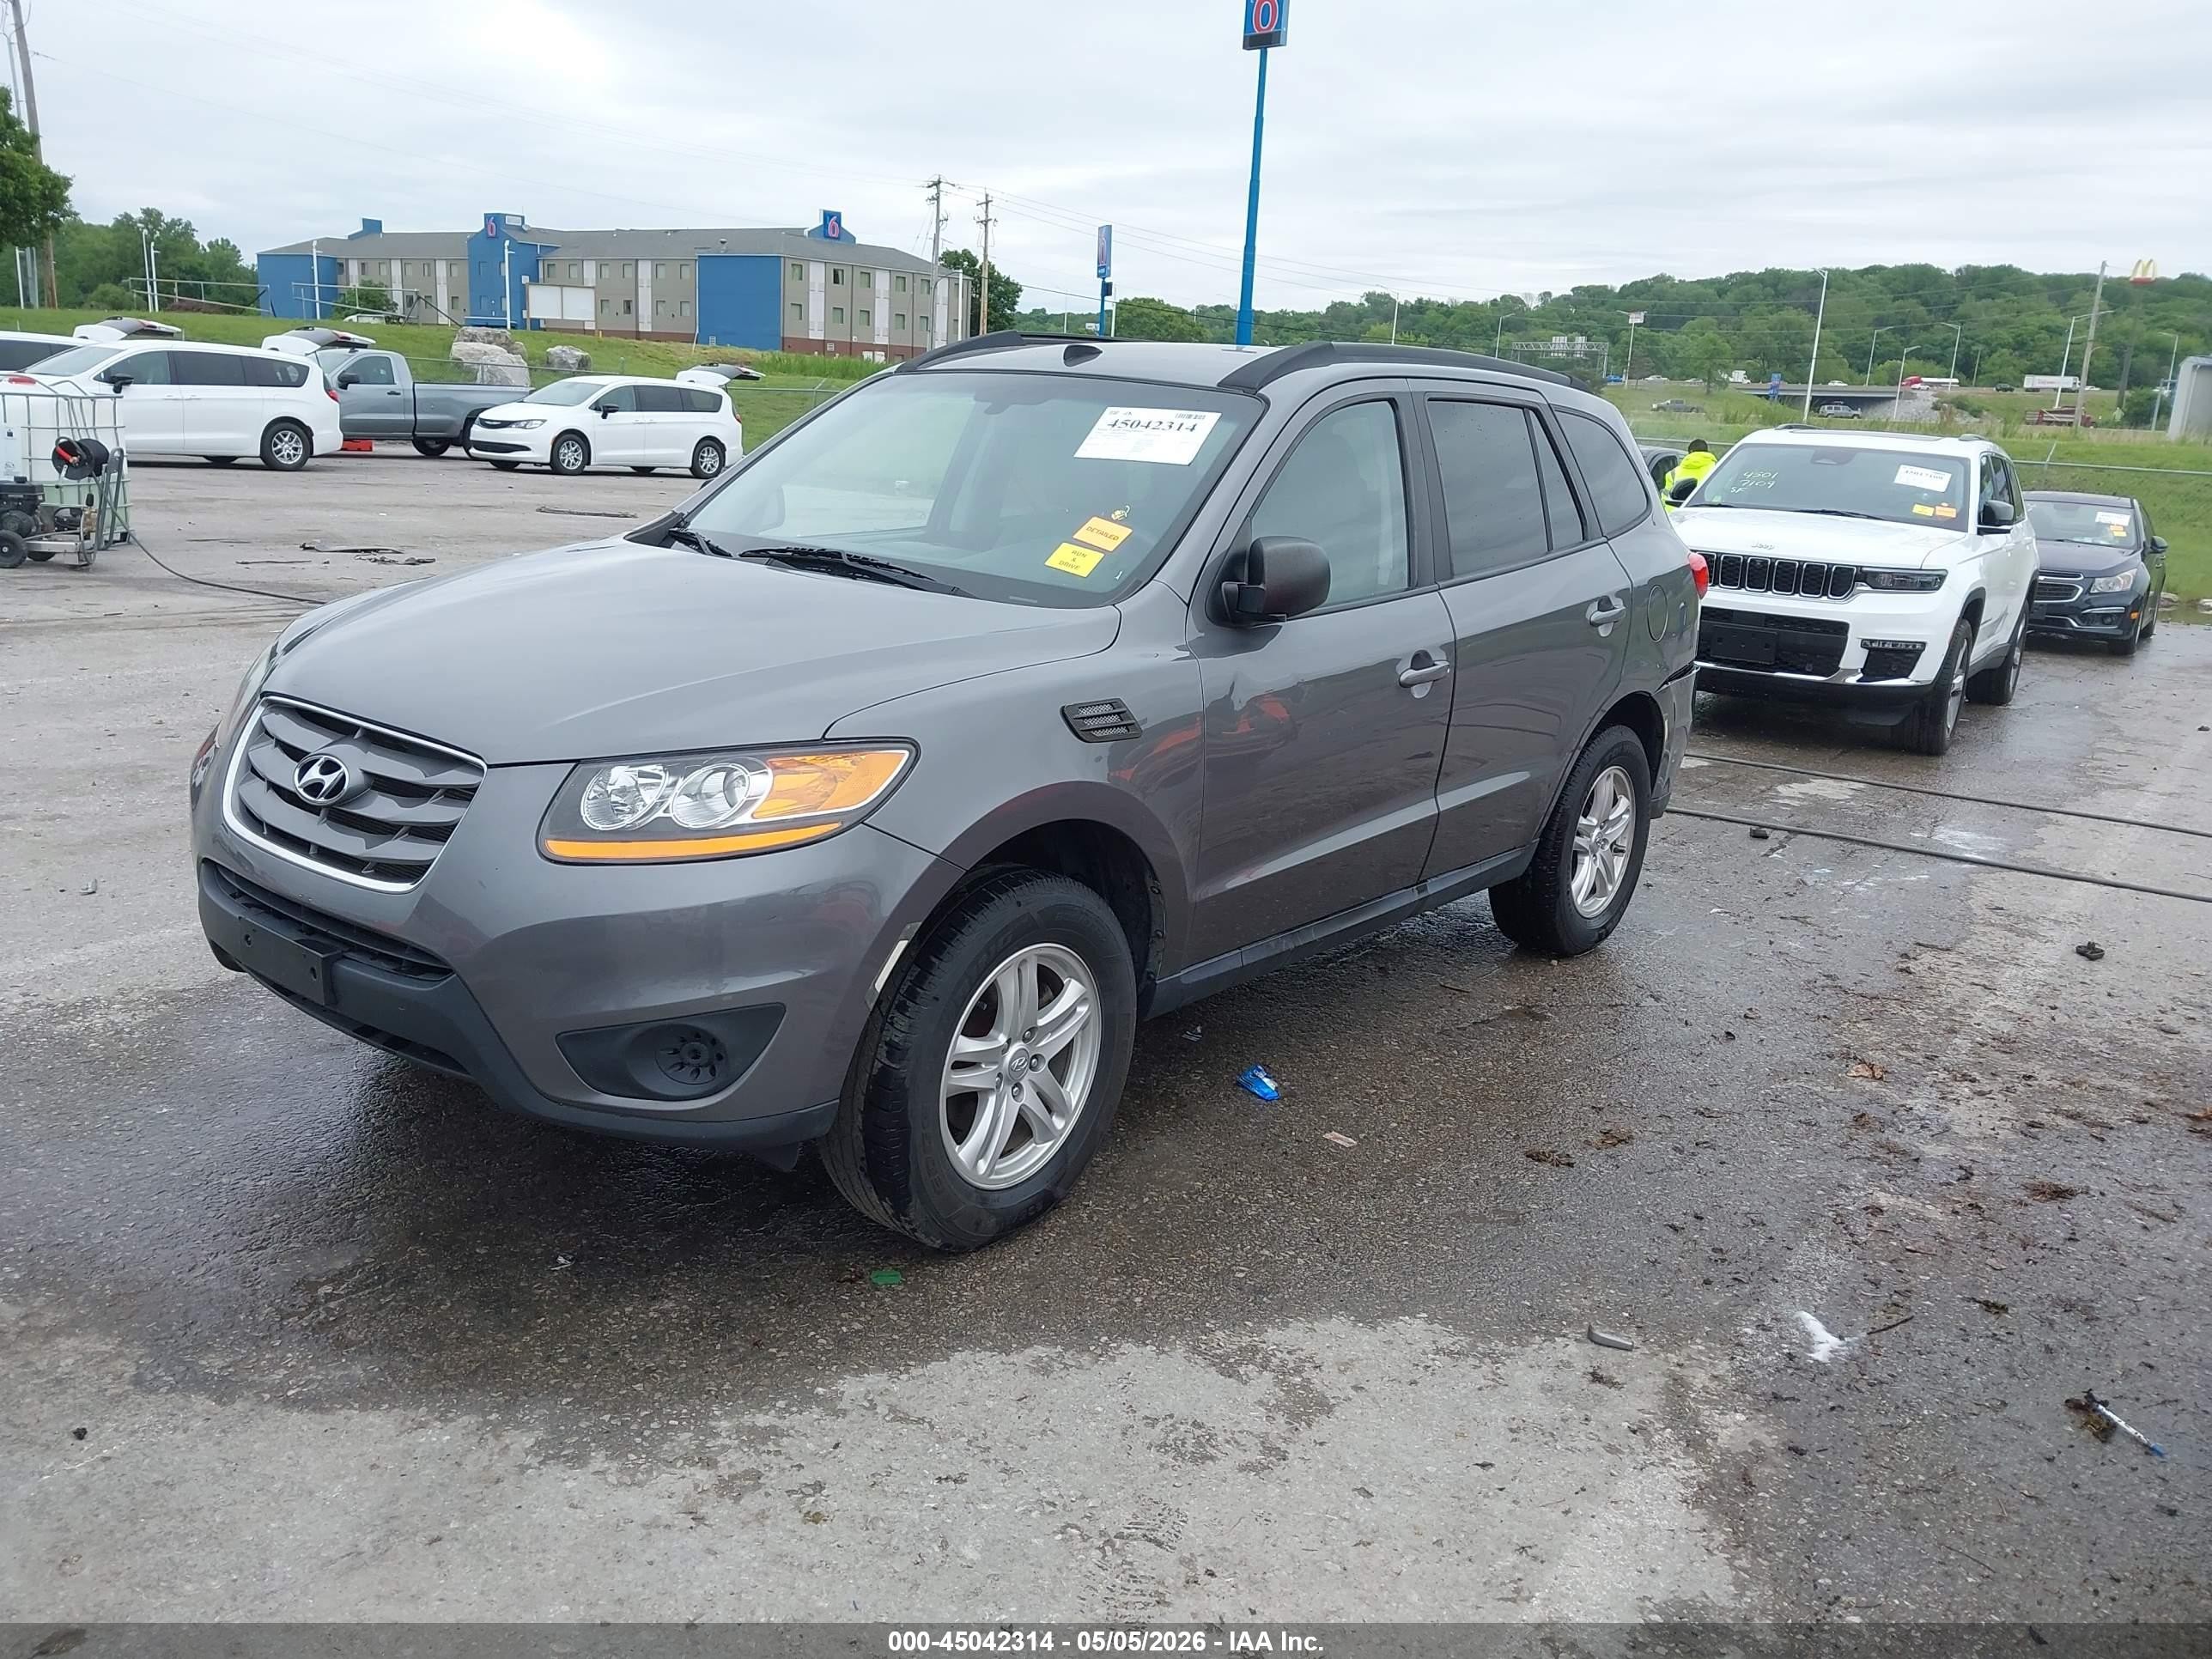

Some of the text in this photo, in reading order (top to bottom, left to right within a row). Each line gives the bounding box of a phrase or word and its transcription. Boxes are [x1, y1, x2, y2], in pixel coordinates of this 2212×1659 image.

[487, 216, 496, 238] 6
[828, 216, 840, 238] 6
[1108, 418, 1198, 432] 45042314
[1085, 526, 1120, 541] DETAILED
[1071, 550, 1088, 559] RUN
[1058, 560, 1081, 571] DRIVE
